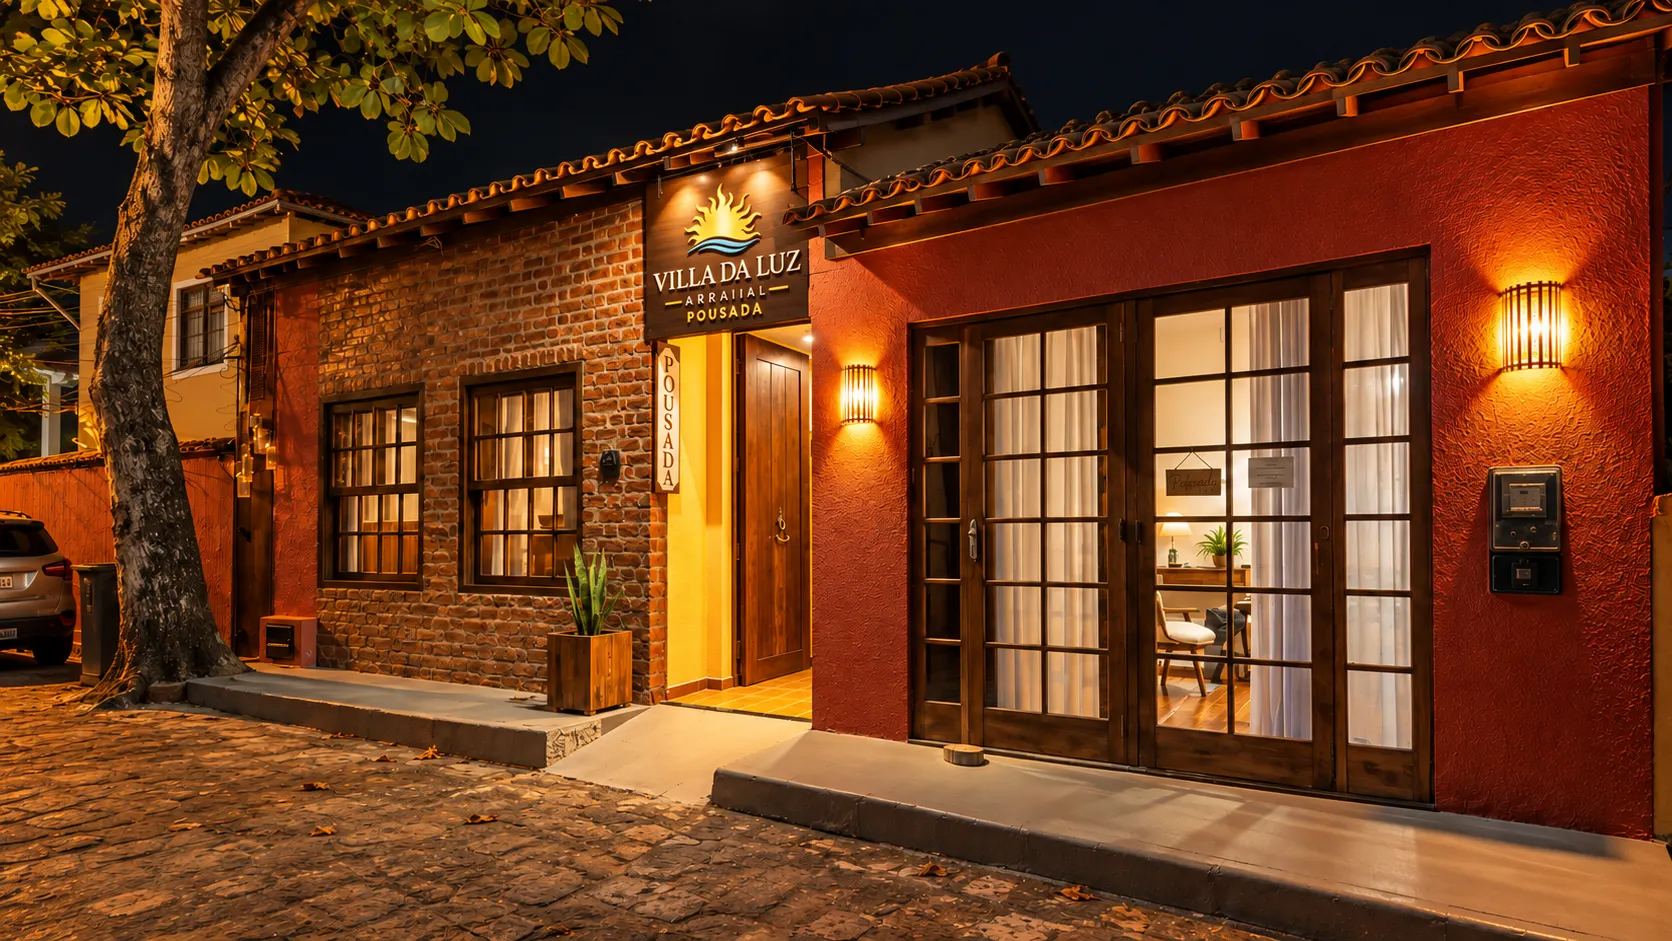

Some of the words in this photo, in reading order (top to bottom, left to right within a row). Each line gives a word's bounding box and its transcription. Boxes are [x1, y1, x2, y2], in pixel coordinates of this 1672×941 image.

[653, 265, 716, 292] VILLA
[720, 259, 751, 283] DA
[756, 250, 801, 277] LUZ
[687, 302, 763, 323] POUSADA
[662, 355, 675, 487] POUSADA
